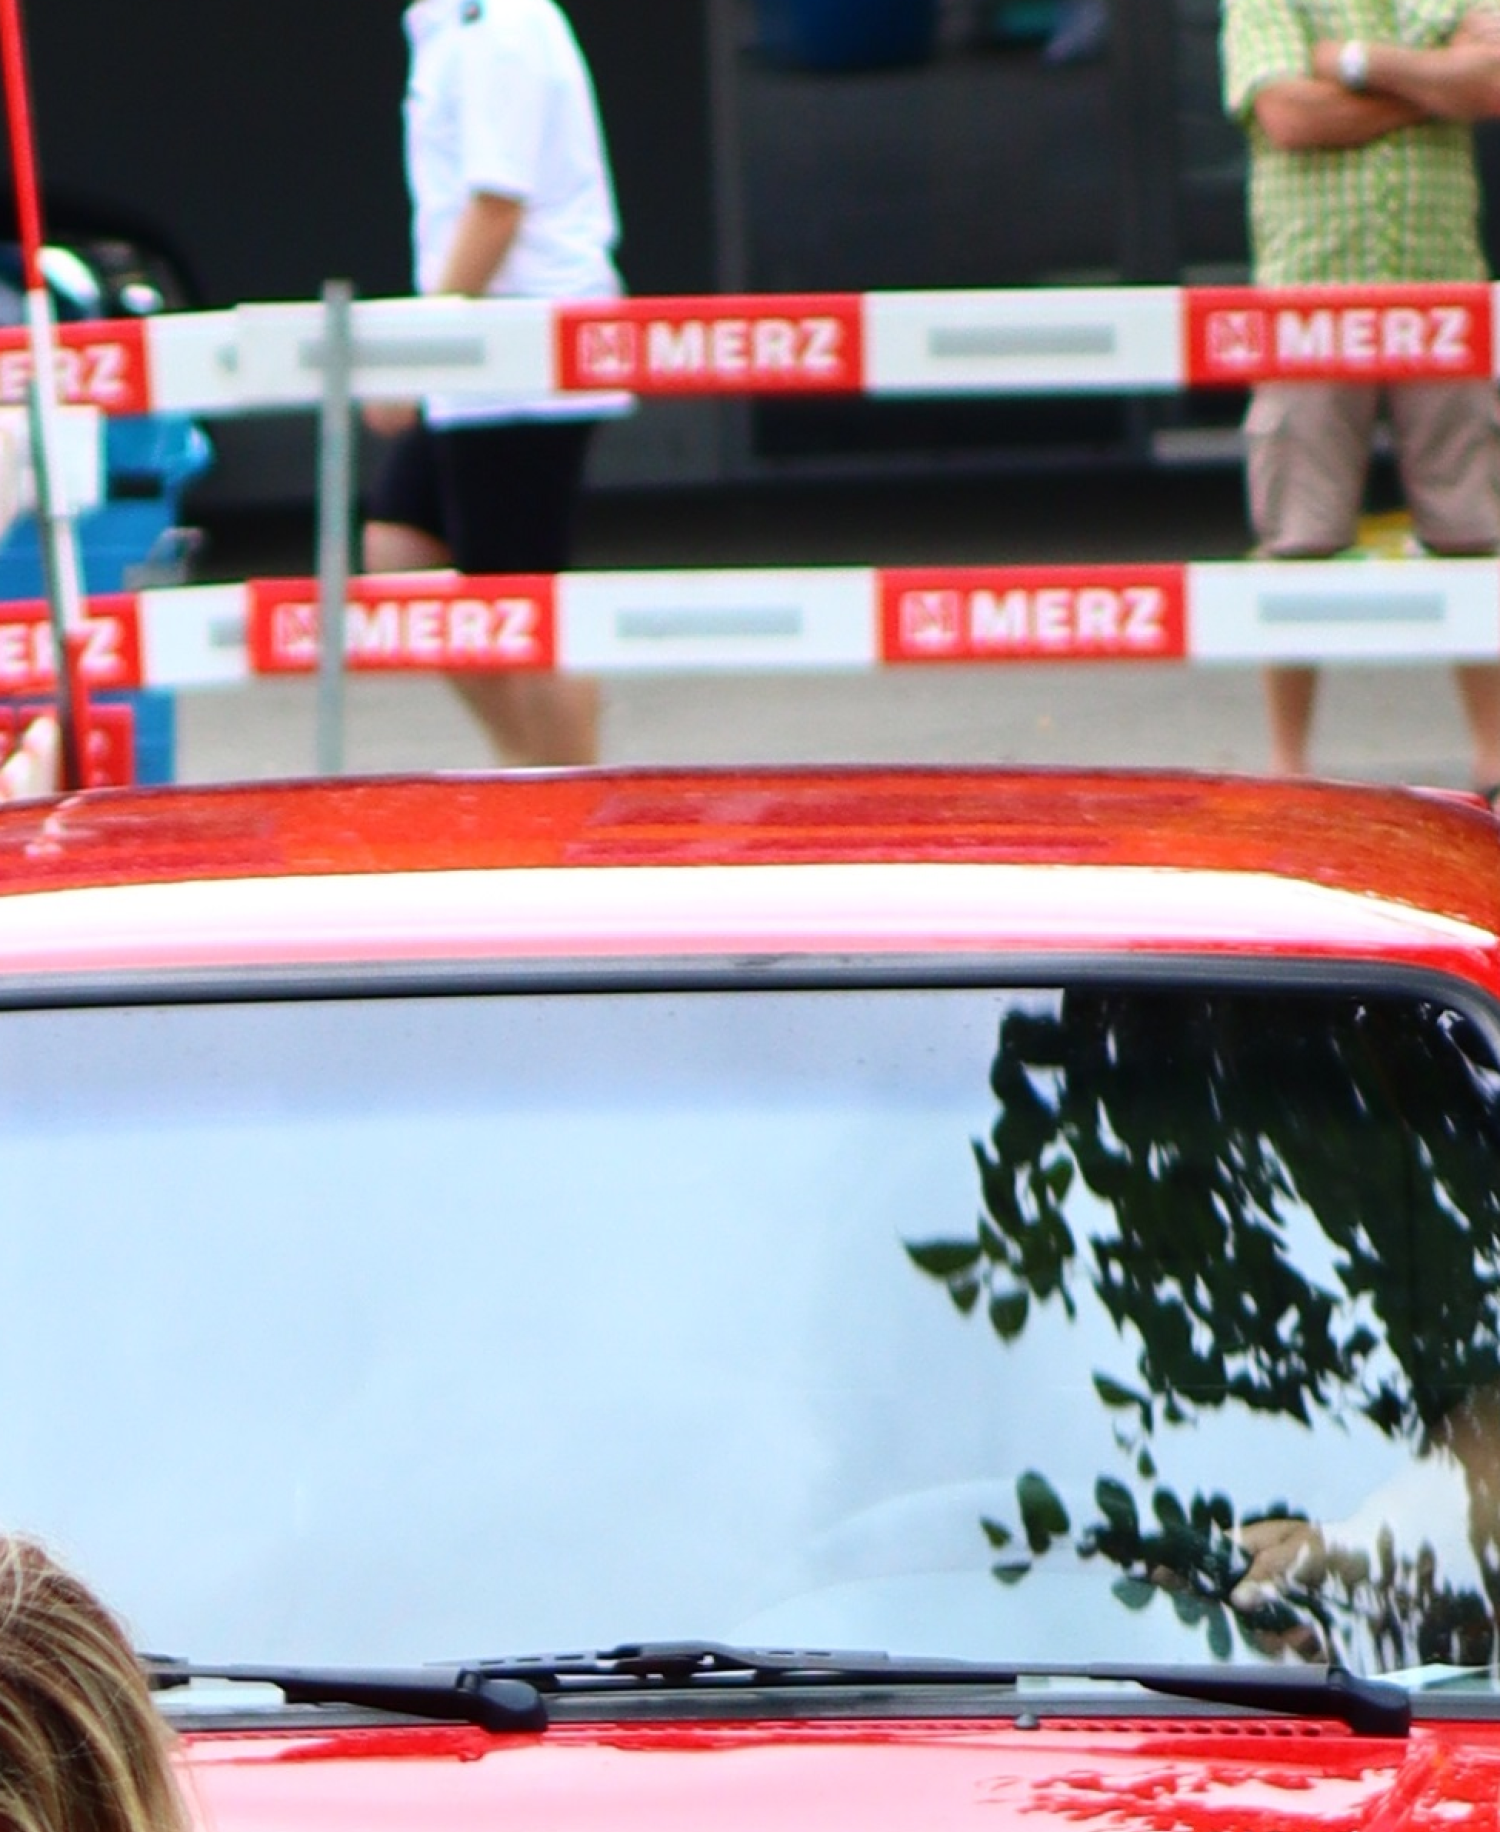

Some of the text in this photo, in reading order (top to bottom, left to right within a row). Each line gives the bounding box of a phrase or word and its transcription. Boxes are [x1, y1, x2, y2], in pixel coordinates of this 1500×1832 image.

[647, 316, 842, 377] MERZ
[1276, 307, 1470, 365] MERZ
[344, 598, 535, 657] MERZ
[970, 587, 1165, 646] MERZ
